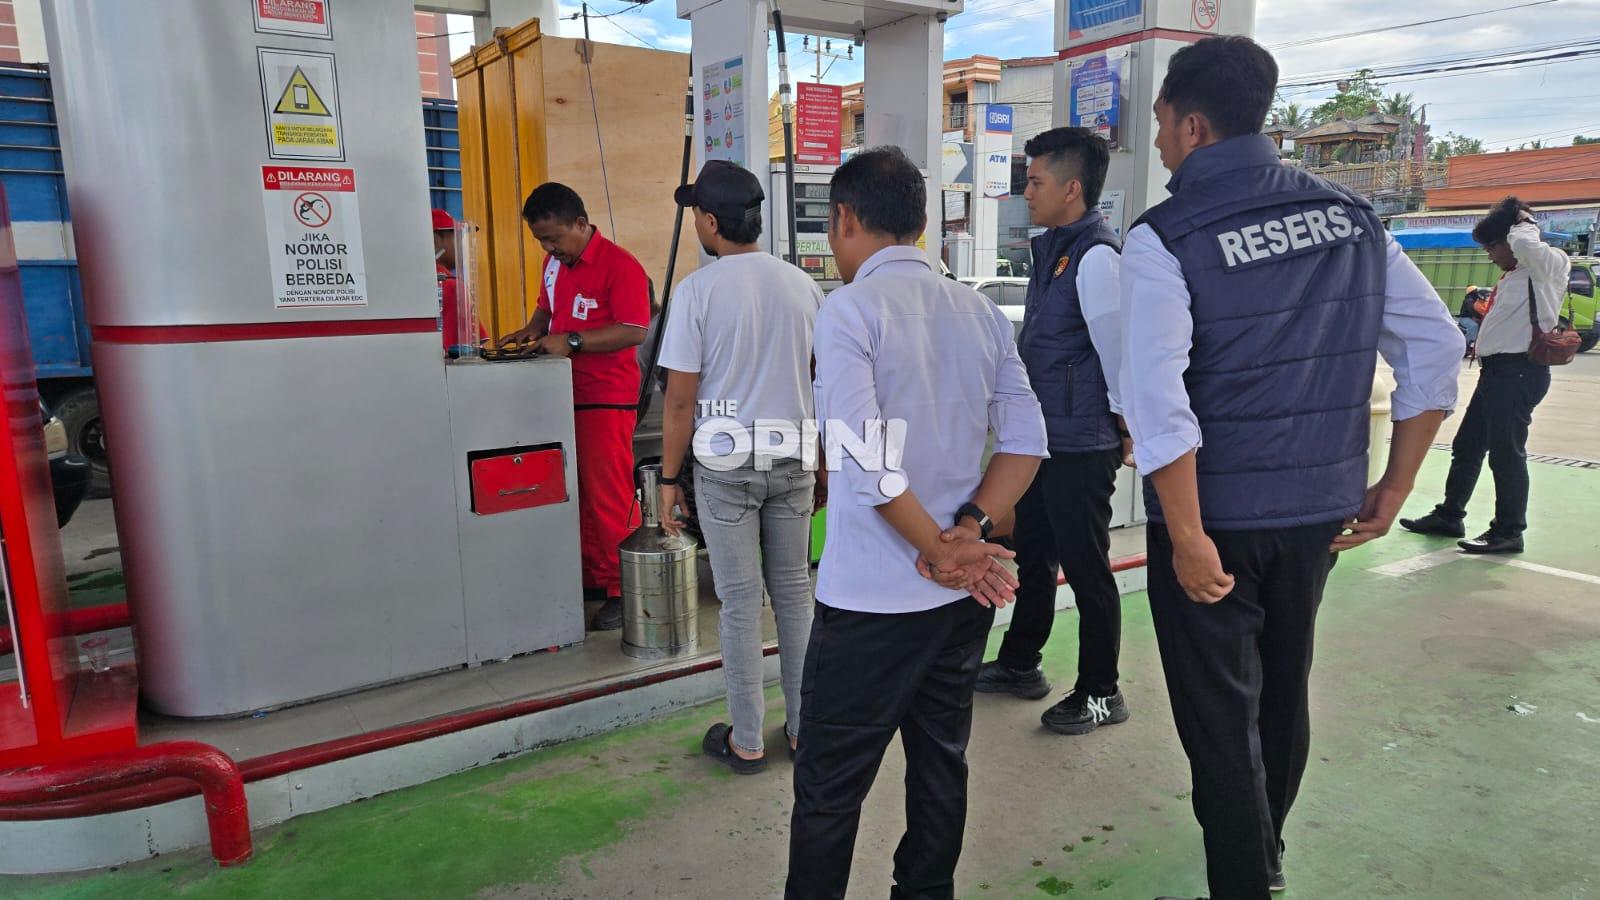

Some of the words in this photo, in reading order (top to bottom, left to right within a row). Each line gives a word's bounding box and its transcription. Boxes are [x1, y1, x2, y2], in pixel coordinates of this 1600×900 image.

[989, 154, 1007, 163] ATM
[277, 171, 340, 182] DILARANG
[302, 233, 330, 242] JIKA
[285, 243, 348, 255] NOMOR
[795, 241, 832, 253] PERTALI
[296, 259, 342, 270] POLISI
[286, 273, 355, 286] BERBEDA
